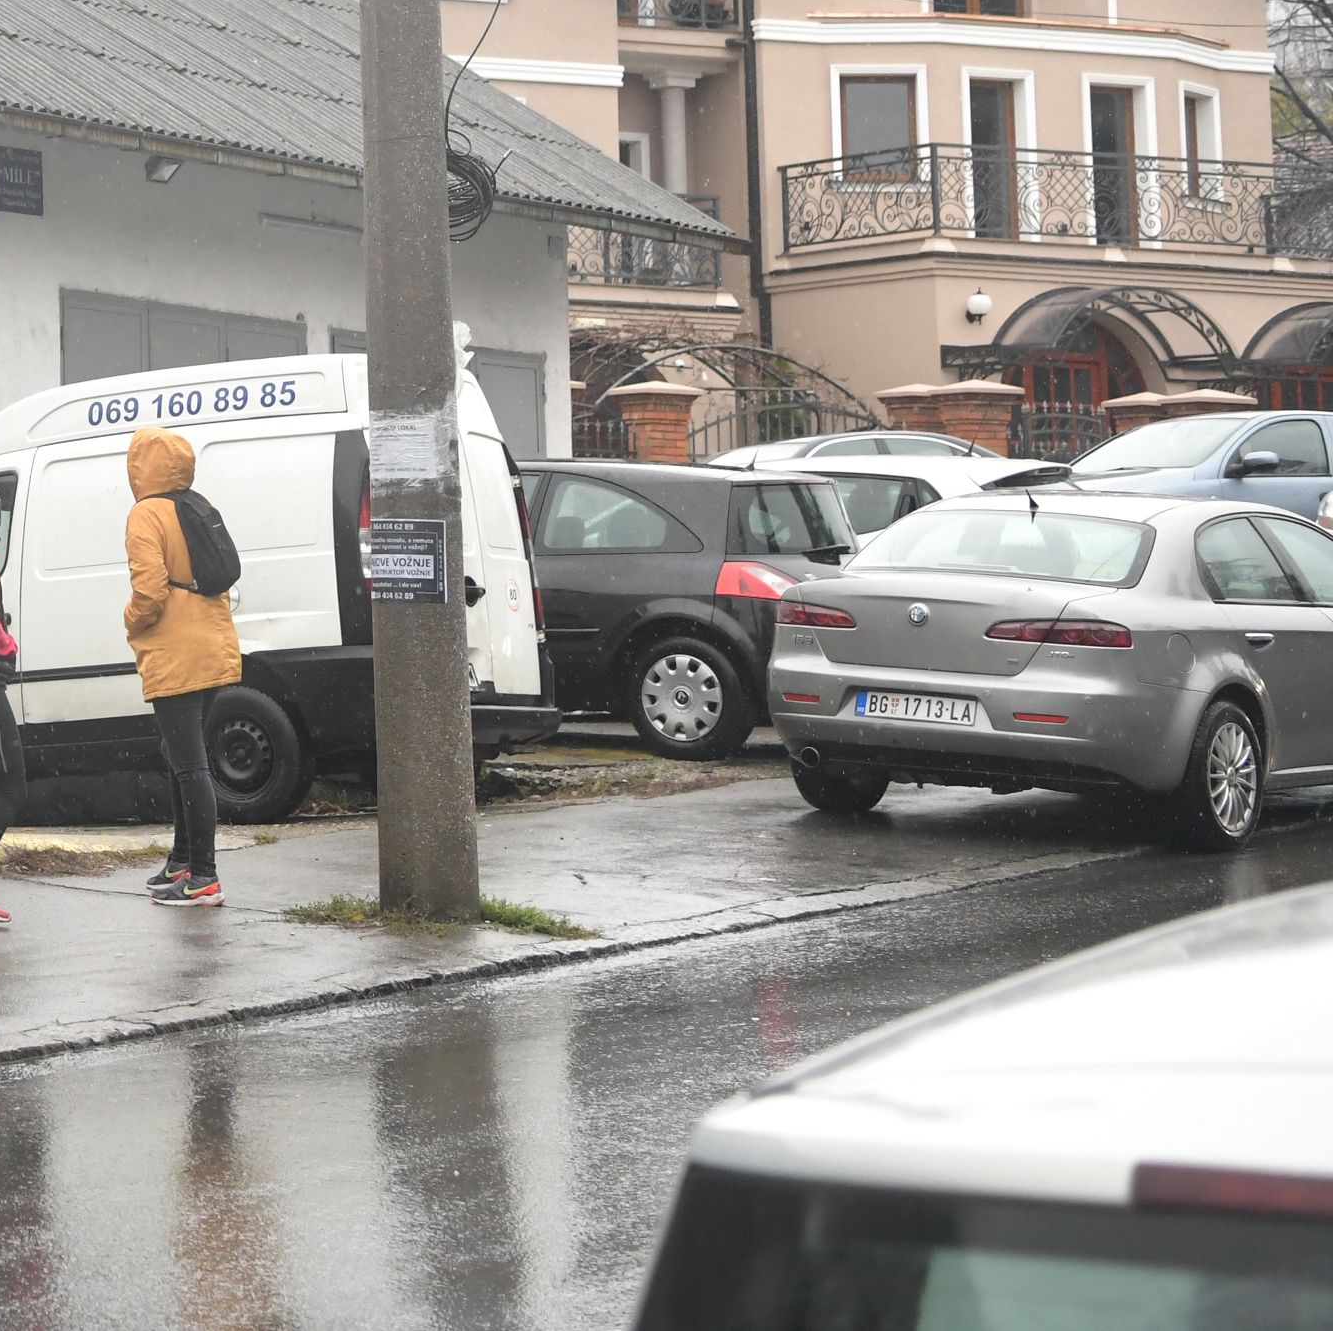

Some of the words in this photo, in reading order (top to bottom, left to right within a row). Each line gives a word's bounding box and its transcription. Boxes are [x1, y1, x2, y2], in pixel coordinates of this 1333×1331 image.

[88, 397, 139, 426] 069
[151, 390, 202, 419] 160
[213, 385, 249, 413] 89
[260, 380, 296, 408] 85
[393, 523, 403, 531] 62
[404, 523, 414, 531] 89
[392, 556, 431, 568] VOŽNJE
[406, 568, 431, 577] VOŽNJE
[404, 592, 414, 600] 89
[868, 694, 889, 714] BG
